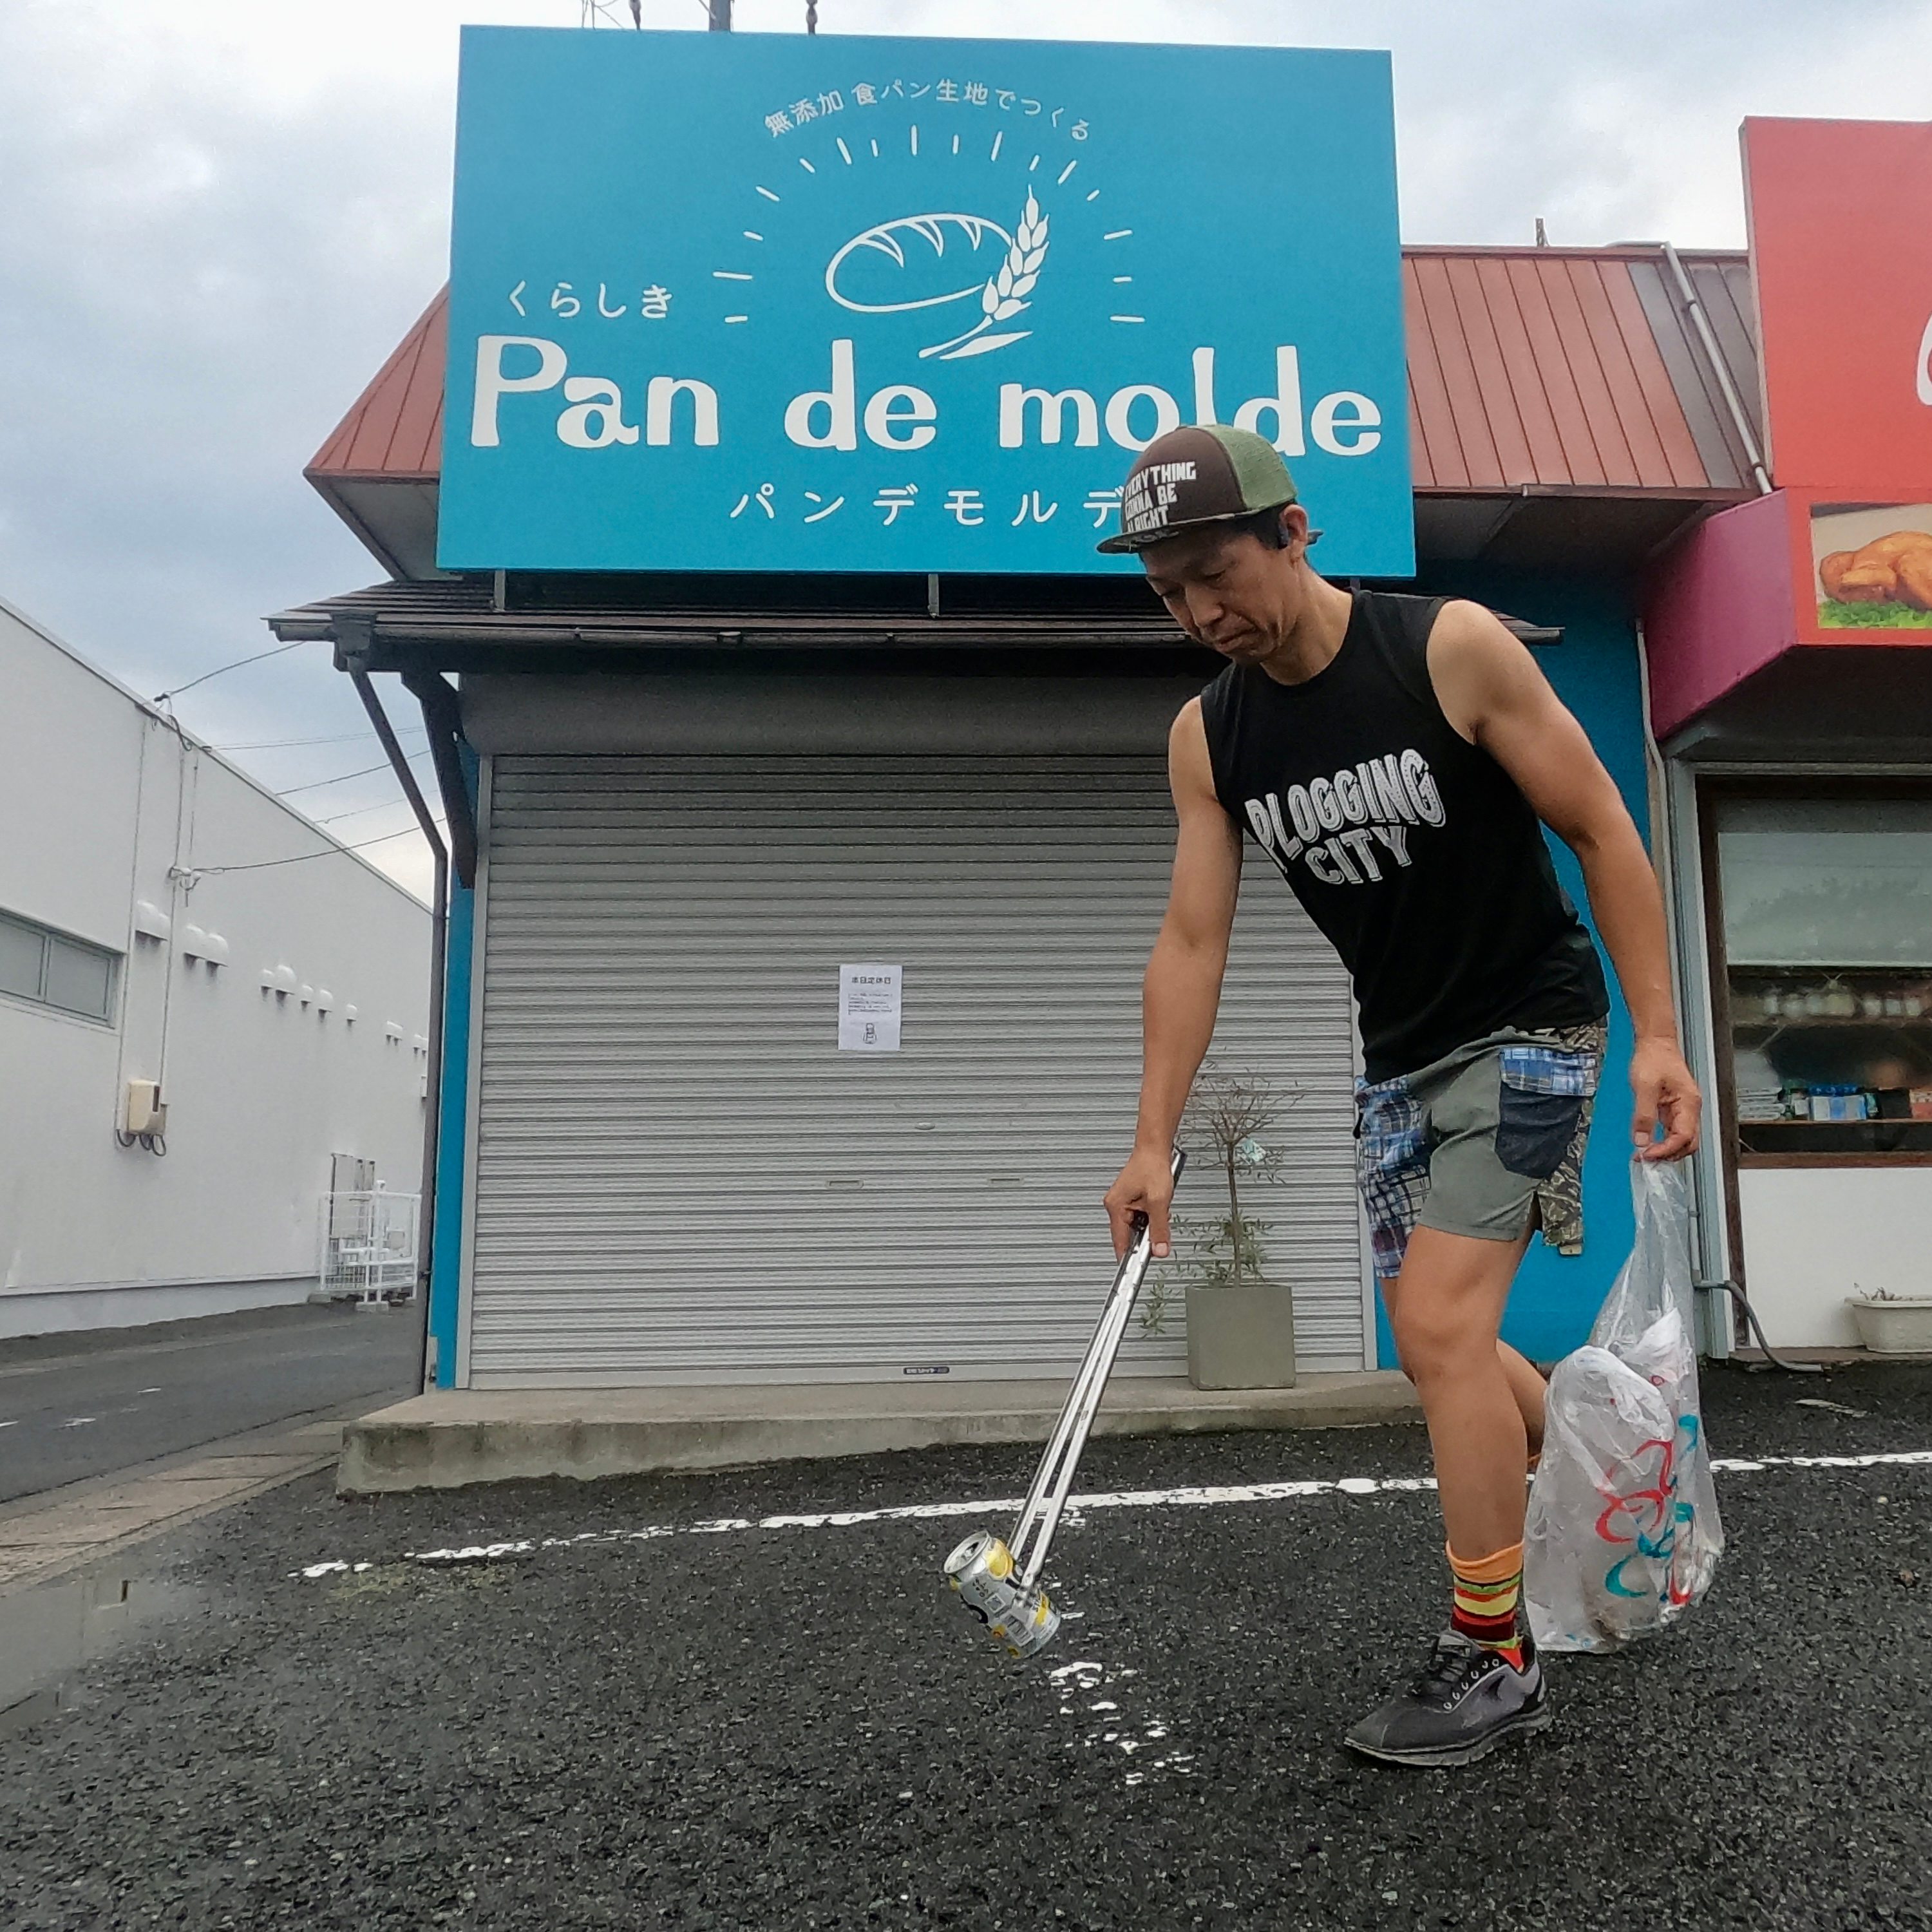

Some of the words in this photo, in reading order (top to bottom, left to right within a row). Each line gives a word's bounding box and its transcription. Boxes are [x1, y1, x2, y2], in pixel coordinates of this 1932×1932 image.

[764, 90, 844, 137] 無添加
[851, 79, 1089, 141] 食パン生地でつくる
[509, 281, 672, 318] くらしき
[471, 335, 719, 448] Pan
[784, 339, 938, 451] de
[999, 345, 1382, 456] molde
[730, 483, 1122, 528] パンデモルデ
[1157, 483, 1177, 505] BE
[1244, 748, 1446, 873] PLOGGING
[1305, 826, 1412, 884] CITY
